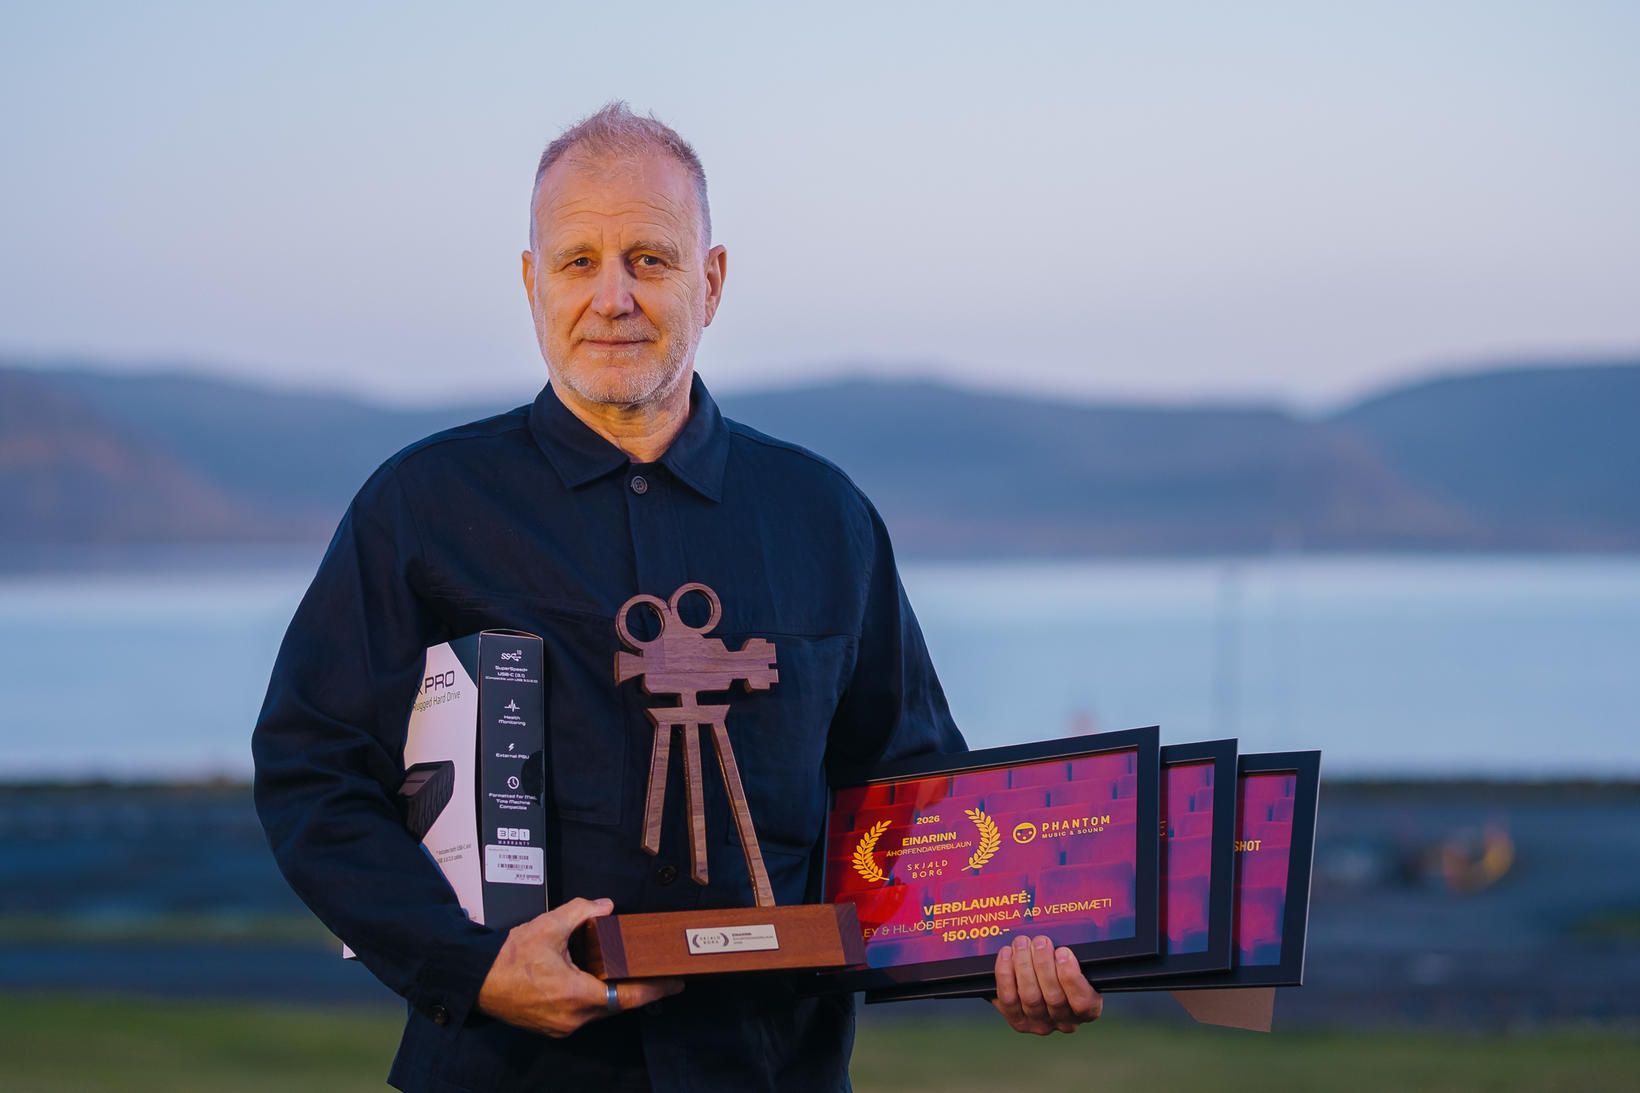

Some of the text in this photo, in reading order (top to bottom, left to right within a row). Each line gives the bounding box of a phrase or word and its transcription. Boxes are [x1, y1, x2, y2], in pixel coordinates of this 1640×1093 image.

[433, 692, 446, 705] Hard
[447, 690, 460, 702] Drive
[498, 719, 527, 727] Monitoring
[916, 815, 940, 825] 2026
[1042, 815, 1111, 832] PHANTOM
[1042, 831, 1067, 839] MUSIC
[1077, 826, 1104, 835] SOUND
[902, 832, 957, 847] EINARINN
[1234, 840, 1261, 852] SHOT
[907, 859, 948, 871] SKJALD
[912, 869, 943, 879] BORG
[923, 890, 1032, 916] VERÐLAUNAFÉ:
[1023, 906, 1042, 918] AÐ
[1044, 898, 1112, 915] VERÐMÆTI
